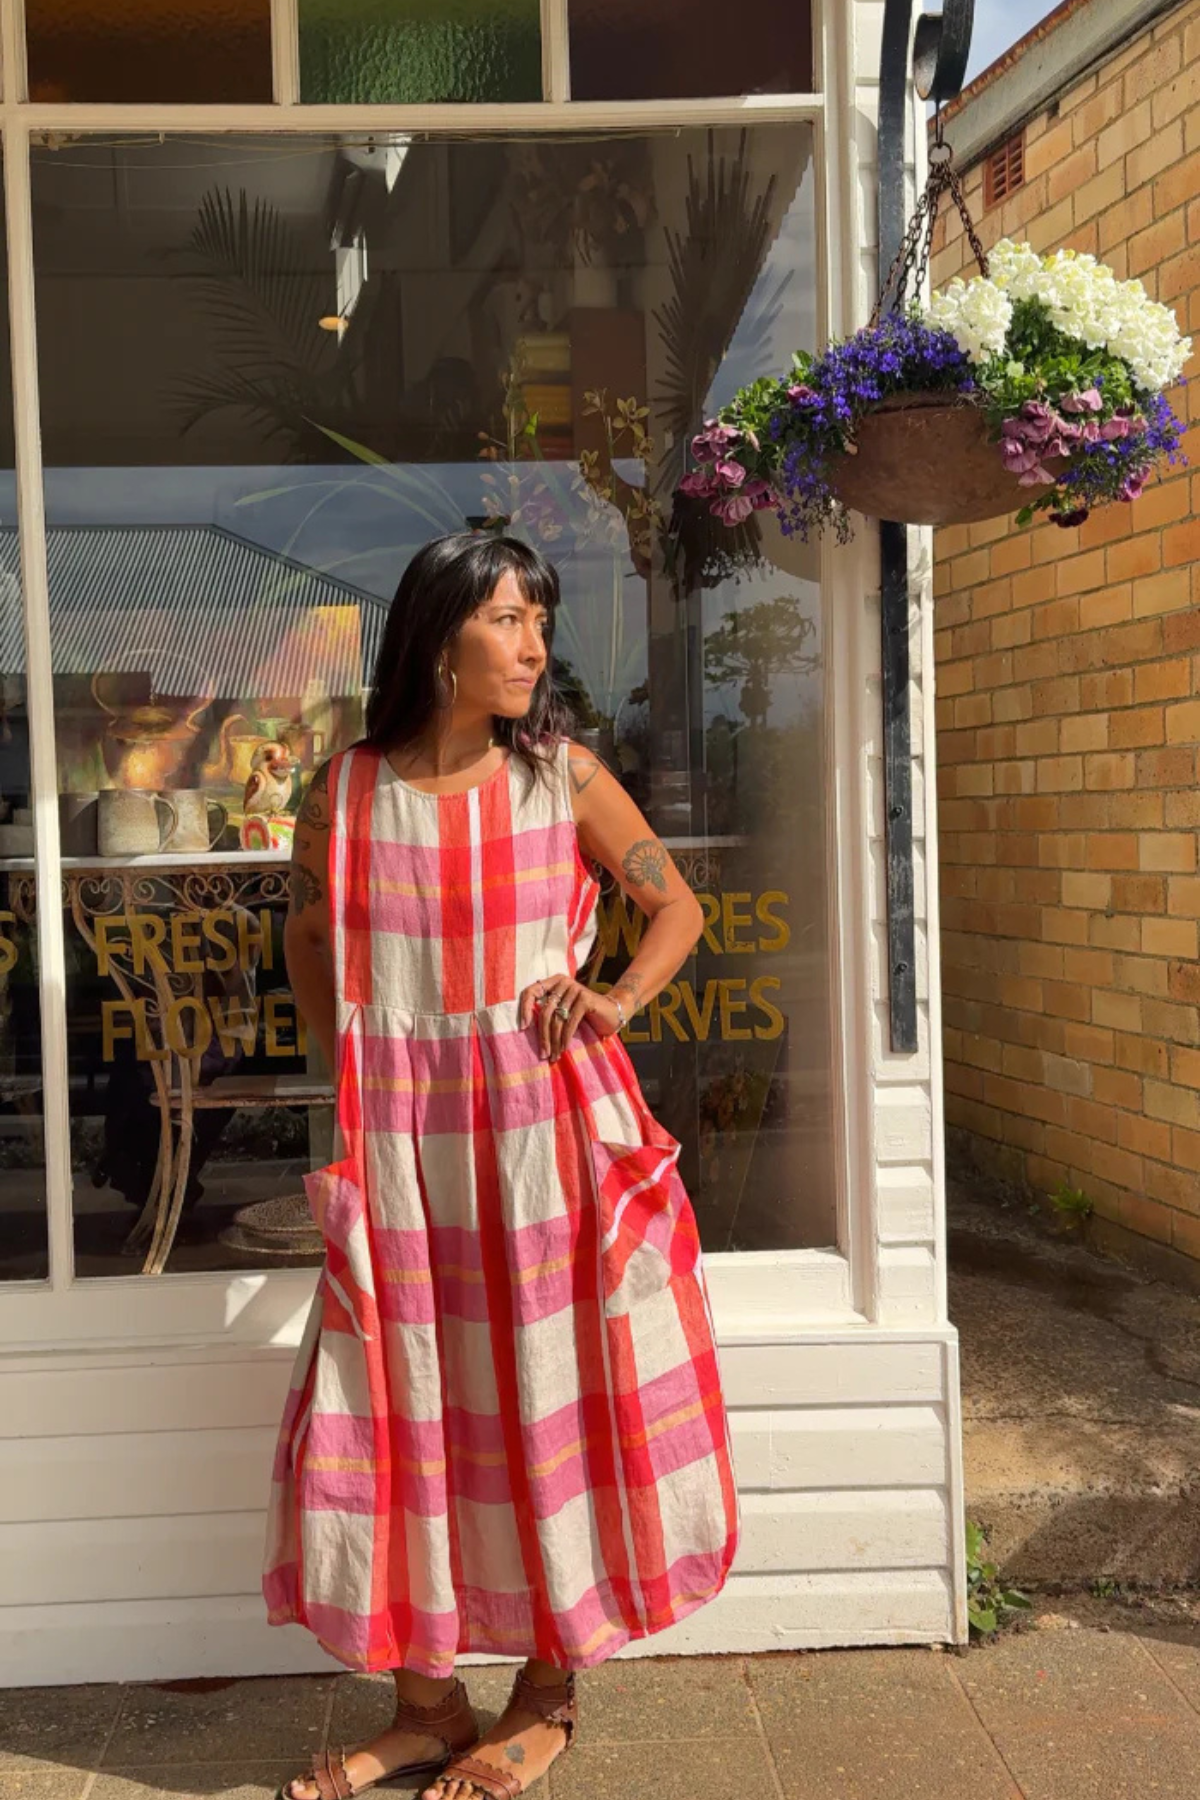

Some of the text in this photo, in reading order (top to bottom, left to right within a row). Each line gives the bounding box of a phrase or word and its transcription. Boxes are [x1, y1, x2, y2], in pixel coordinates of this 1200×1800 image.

[94, 908, 274, 977] FRESH
[597, 890, 791, 957] WRES
[102, 995, 308, 1062] FLOWE
[589, 976, 785, 1043] RVES
